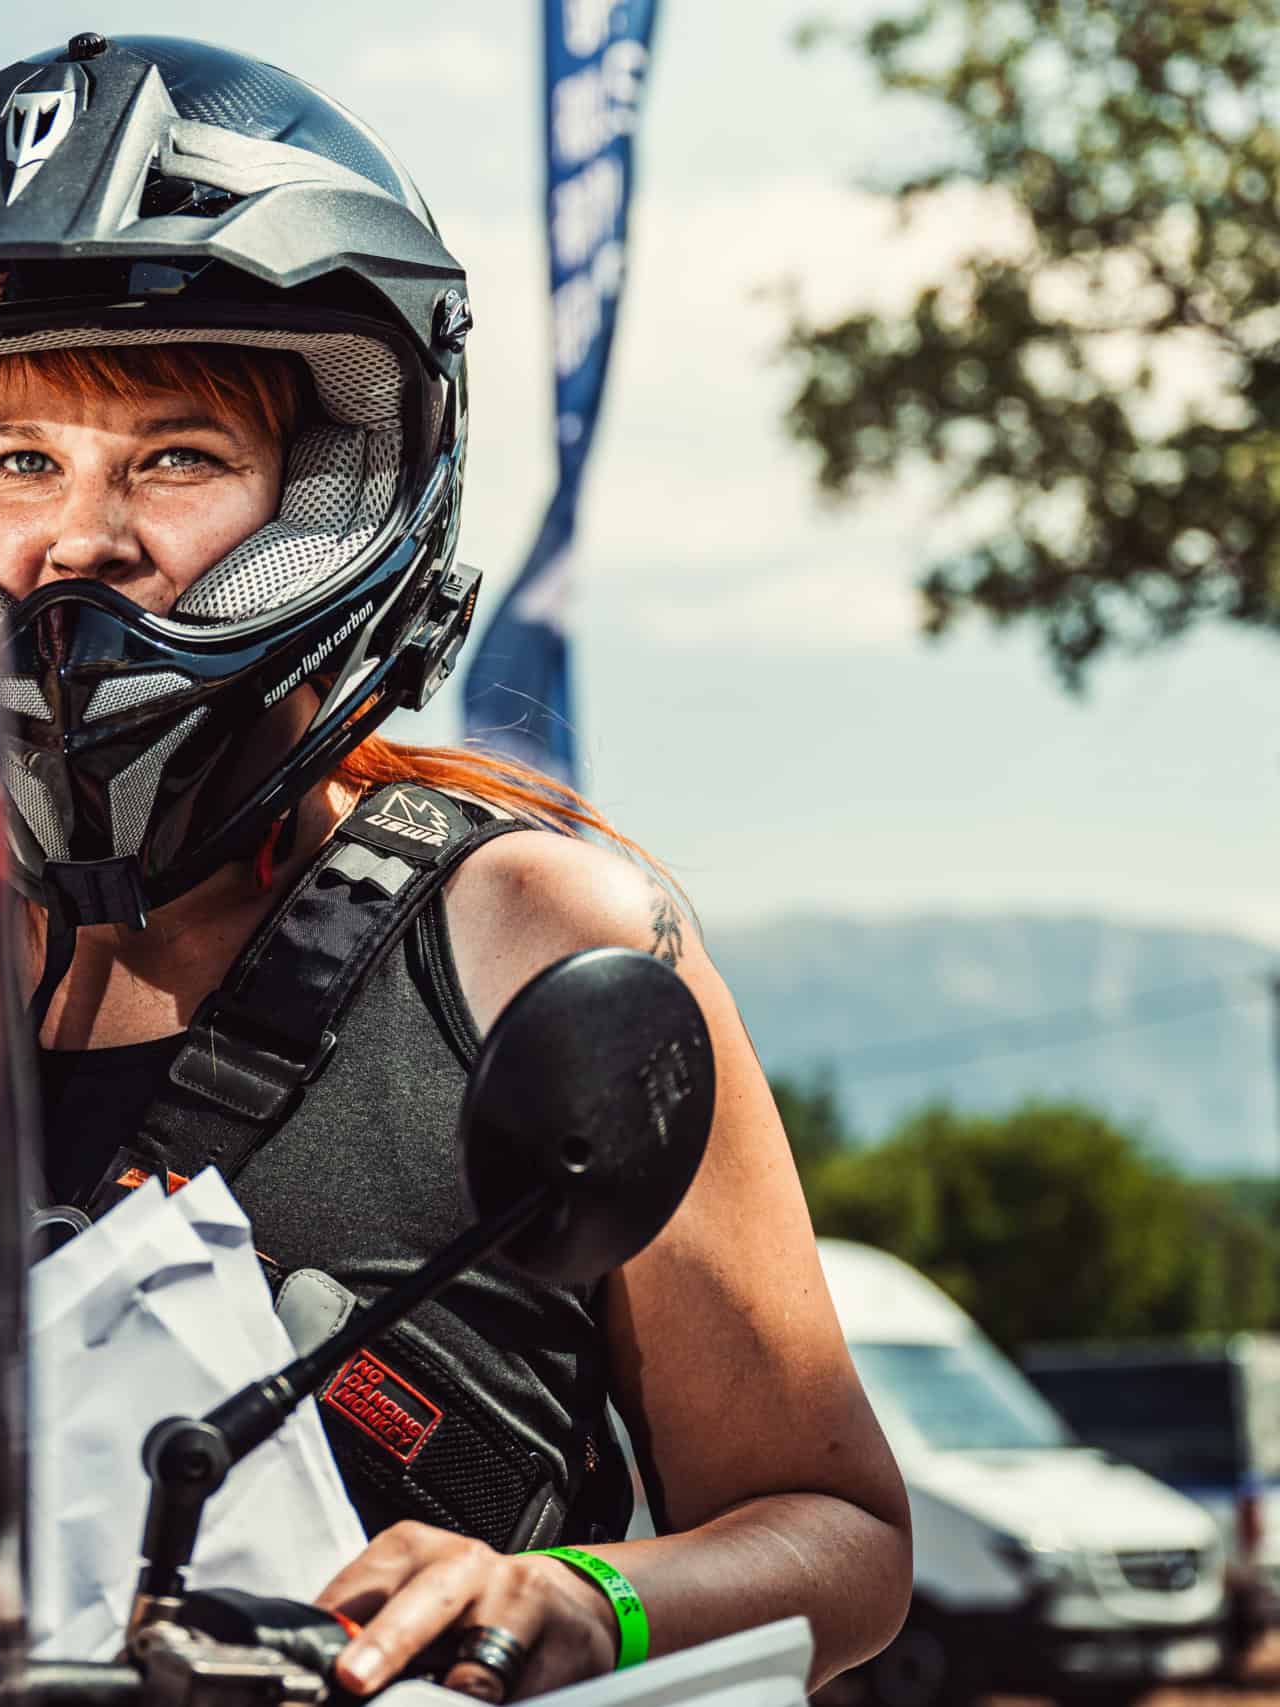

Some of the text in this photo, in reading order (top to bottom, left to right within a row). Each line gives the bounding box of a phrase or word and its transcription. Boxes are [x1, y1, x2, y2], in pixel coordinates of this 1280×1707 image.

[263, 600, 374, 709] super light carbon
[364, 814, 449, 848] USWE
[353, 1359, 385, 1385] NO
[334, 1386, 414, 1447] MONKEY
[344, 1373, 424, 1438] DANCING
